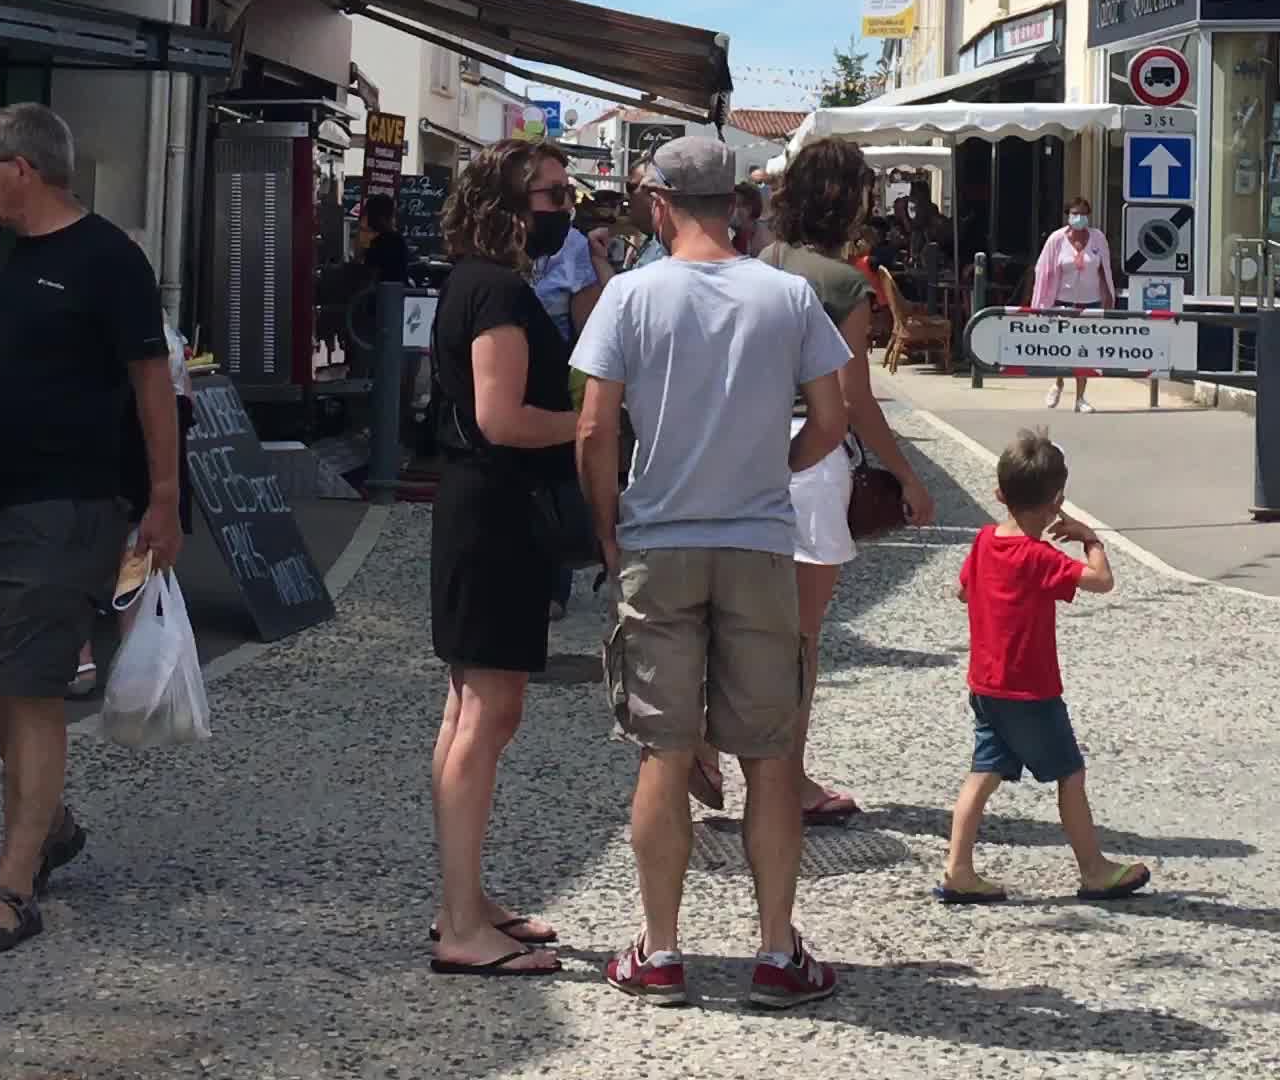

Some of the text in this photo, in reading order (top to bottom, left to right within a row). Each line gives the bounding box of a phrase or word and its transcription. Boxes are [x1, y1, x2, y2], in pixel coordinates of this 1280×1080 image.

[368, 114, 405, 145] CAVE
[1009, 320, 1050, 334] Rue
[1015, 343, 1072, 358] 10h00
[1077, 344, 1089, 358] à
